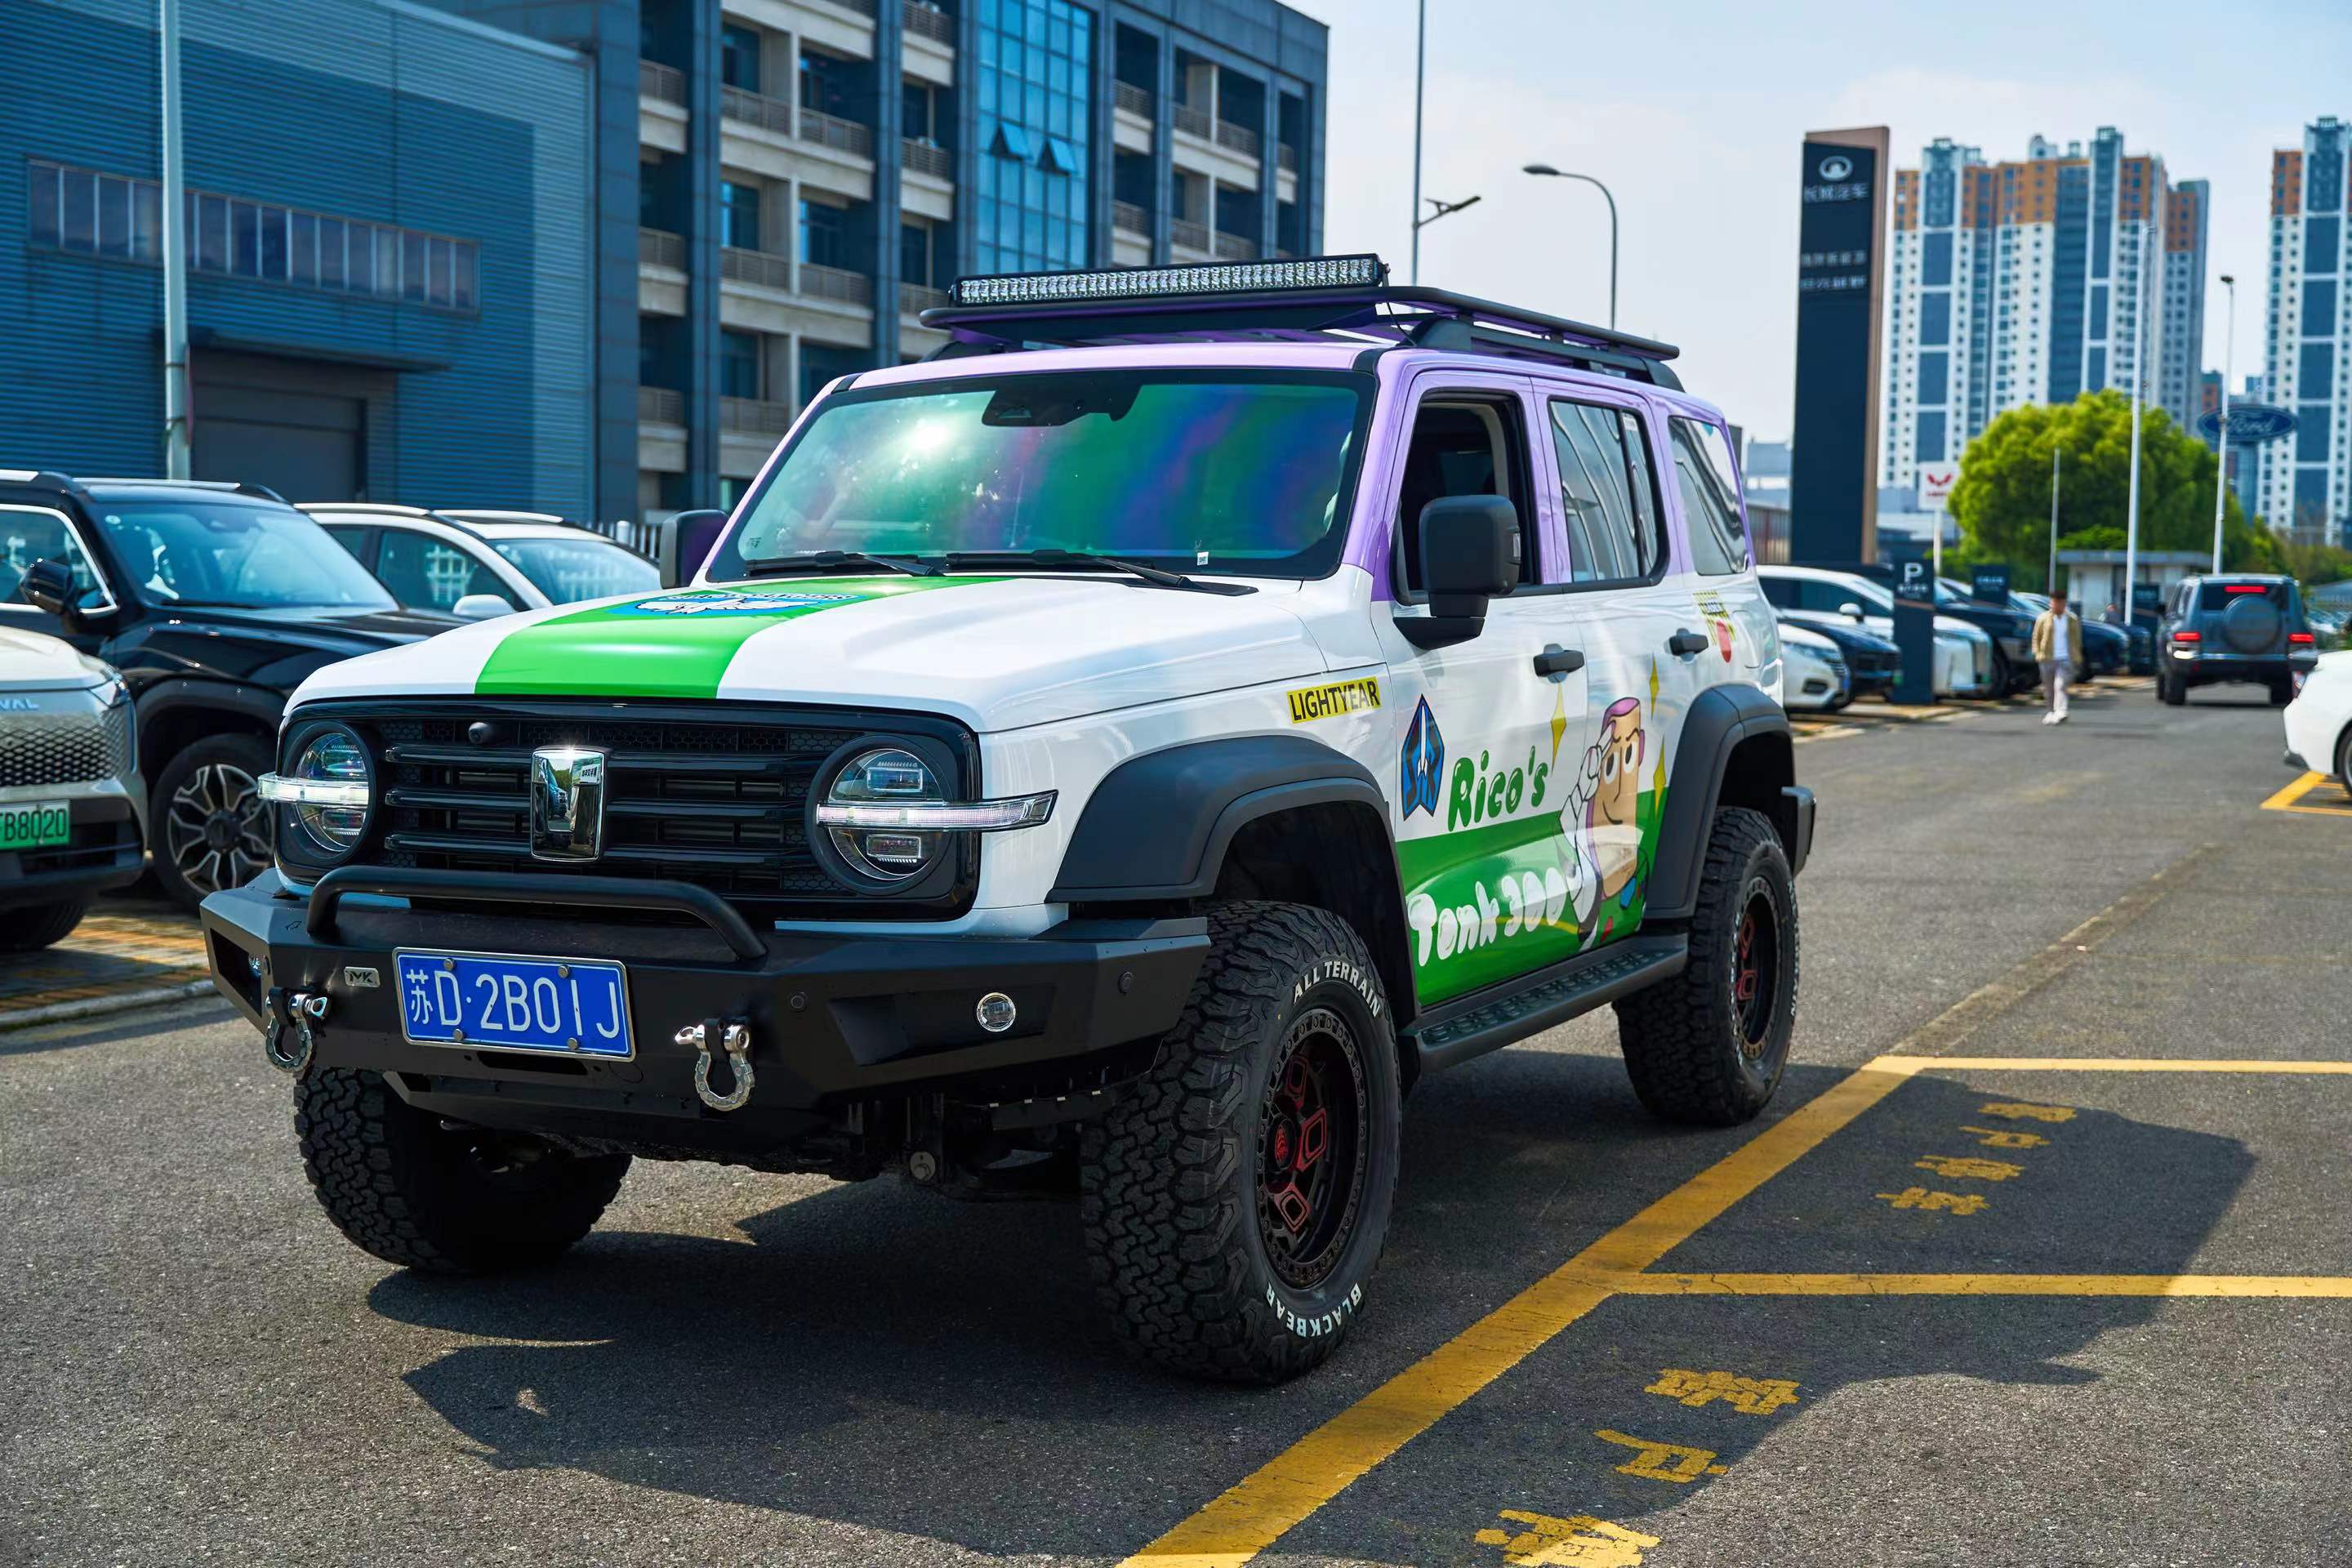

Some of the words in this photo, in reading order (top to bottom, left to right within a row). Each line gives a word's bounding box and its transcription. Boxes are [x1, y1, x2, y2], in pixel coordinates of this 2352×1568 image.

[1904, 562, 1923, 583] P
[1289, 679, 1380, 721] LIGHTYEAR
[1450, 745, 1548, 831] Rico's
[0, 808, 67, 841] B8020
[1294, 967, 1321, 1004] ALL
[1325, 960, 1381, 1018] TERRAIN
[1266, 1283, 1361, 1338] BLACKBEAR
